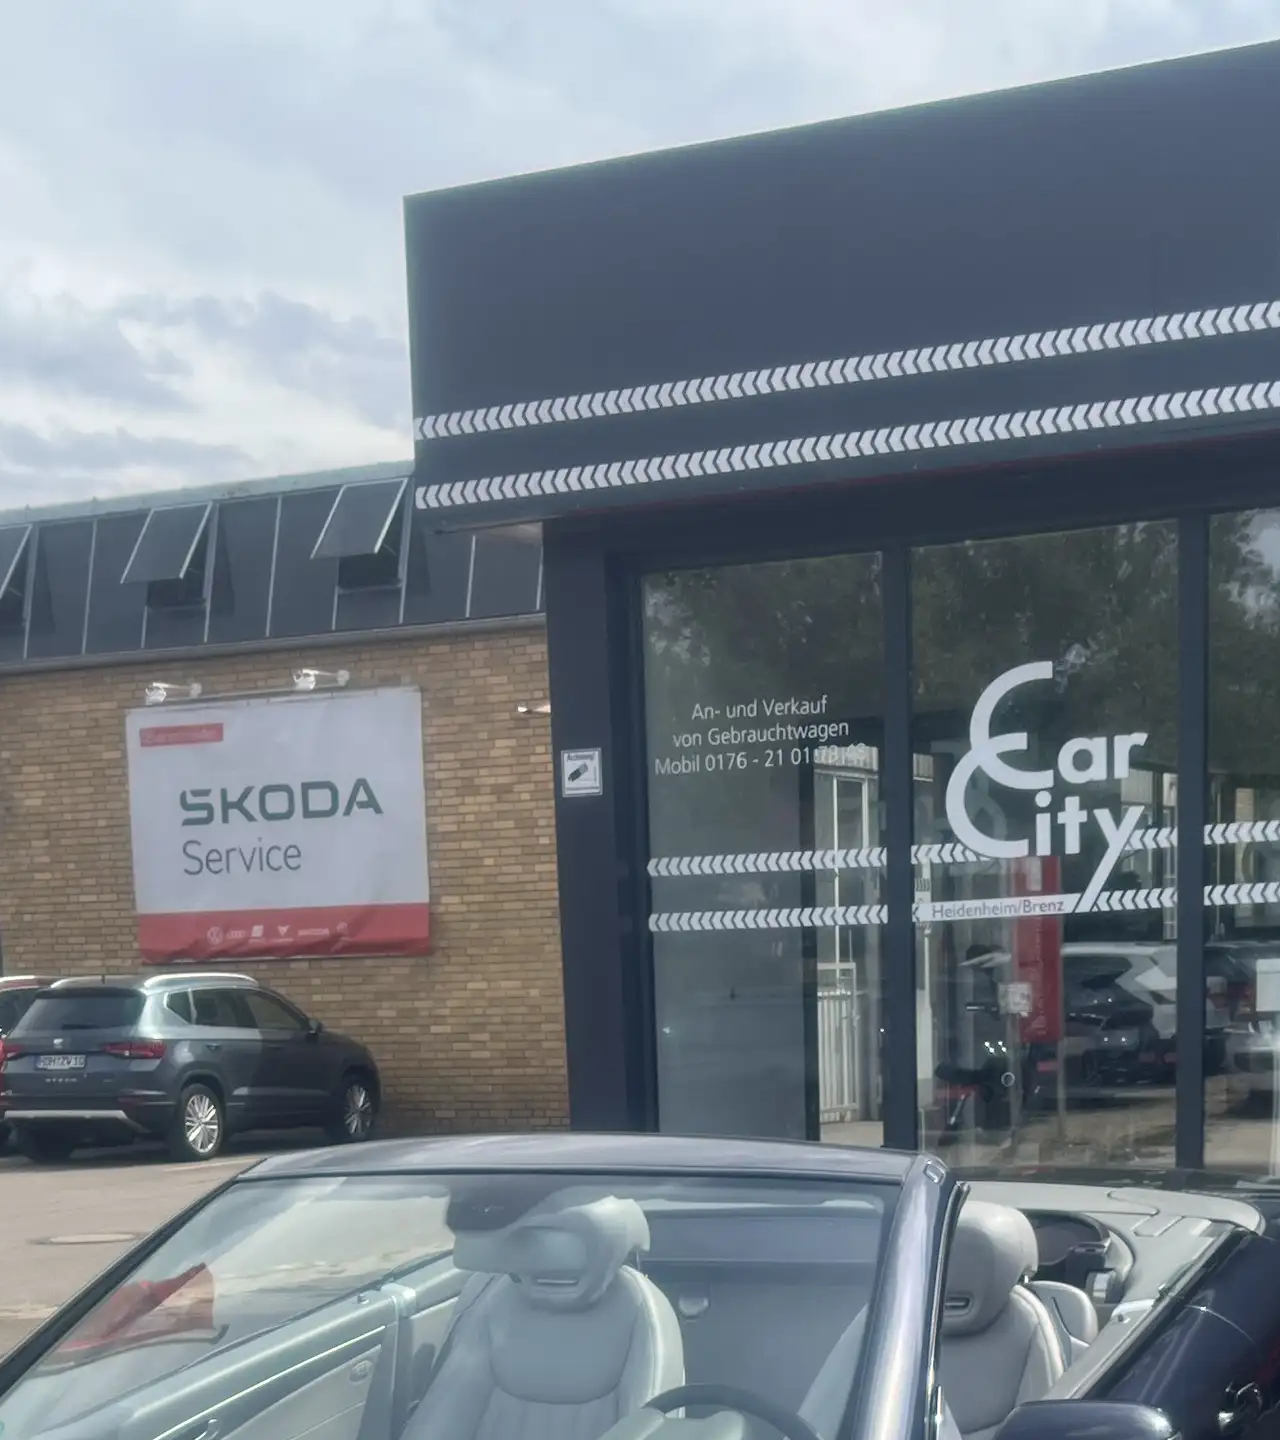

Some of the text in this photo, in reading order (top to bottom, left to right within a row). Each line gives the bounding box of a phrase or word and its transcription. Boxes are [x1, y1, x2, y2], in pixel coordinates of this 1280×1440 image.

[692, 695, 828, 720] An- und Verkauf
[673, 721, 849, 748] von Gebrauchtwagen
[655, 754, 699, 775] Mobil
[705, 752, 747, 772] 0176
[764, 749, 783, 768] 21
[790, 747, 809, 765] 01
[945, 732, 1145, 913] City
[182, 837, 301, 875] Service
[931, 898, 1064, 920] Heidenheim/Brenz
